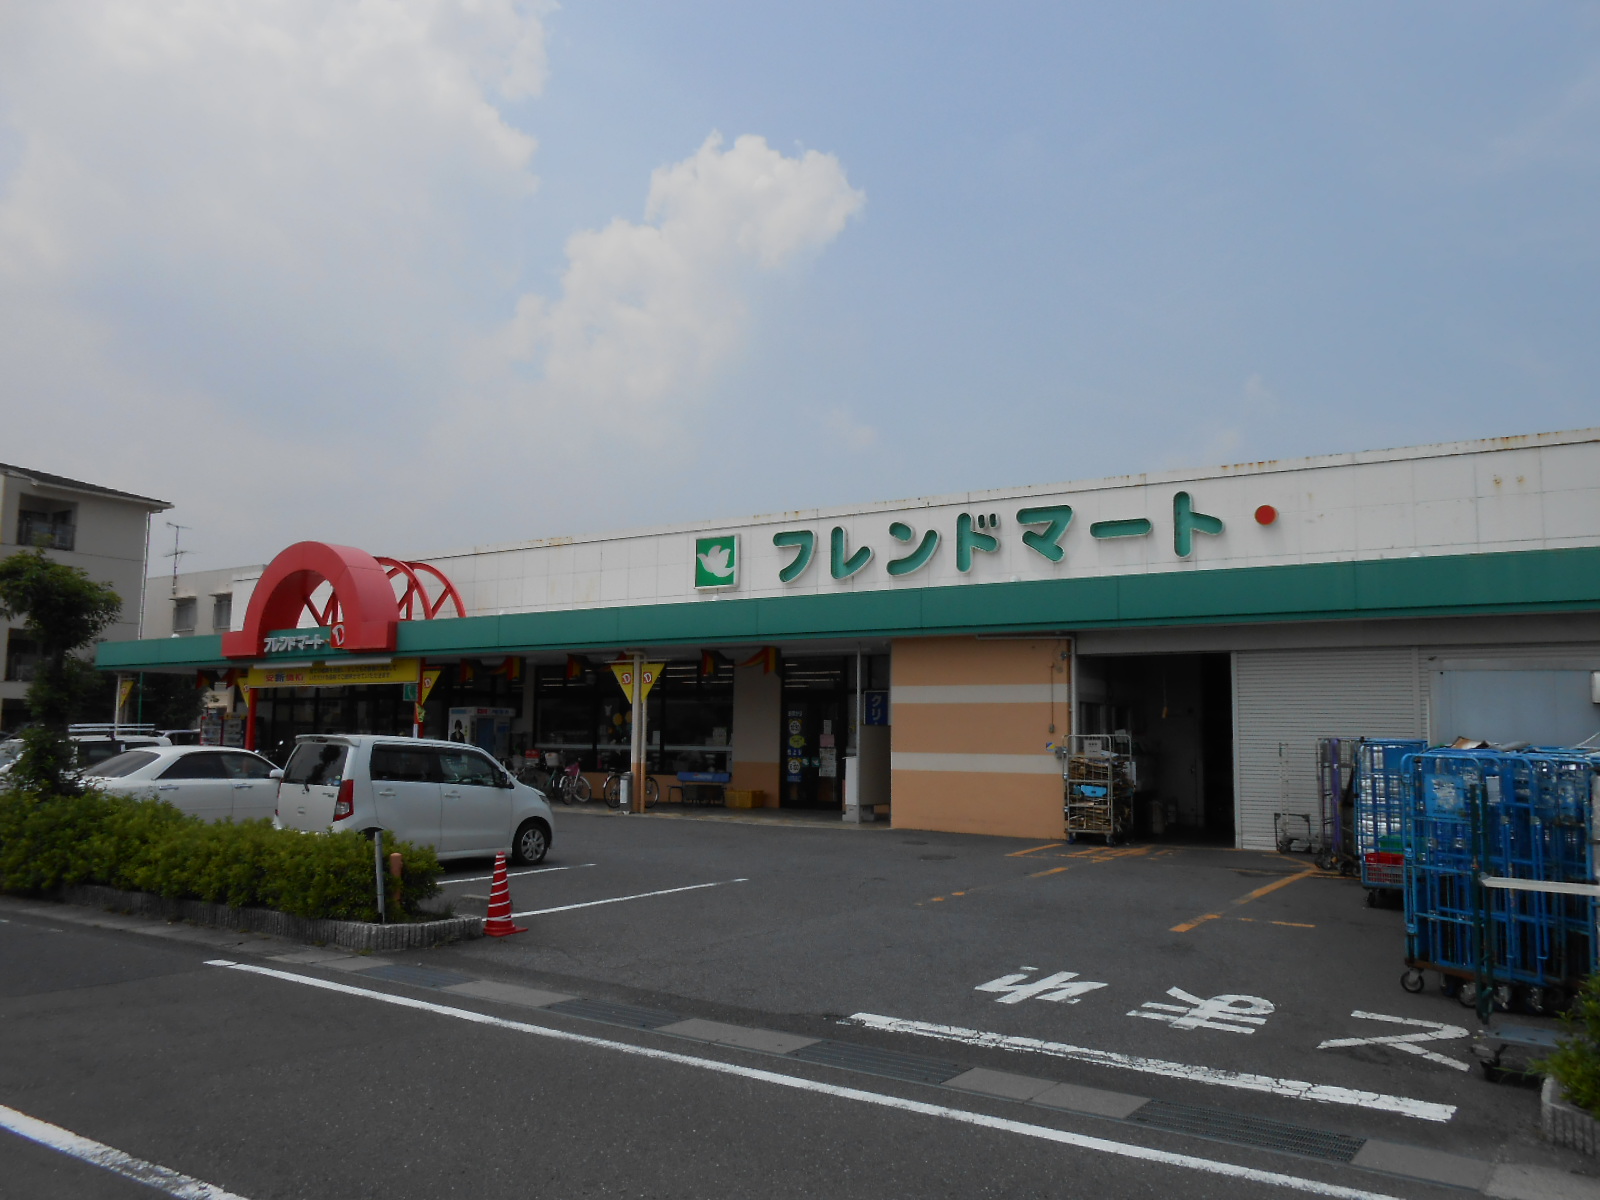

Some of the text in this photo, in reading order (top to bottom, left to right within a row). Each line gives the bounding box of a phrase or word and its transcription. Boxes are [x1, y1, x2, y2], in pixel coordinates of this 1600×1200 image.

[773, 491, 1225, 583] フレンドマート
[263, 633, 325, 653] フレンドマート
[871, 694, 882, 726] クリ
